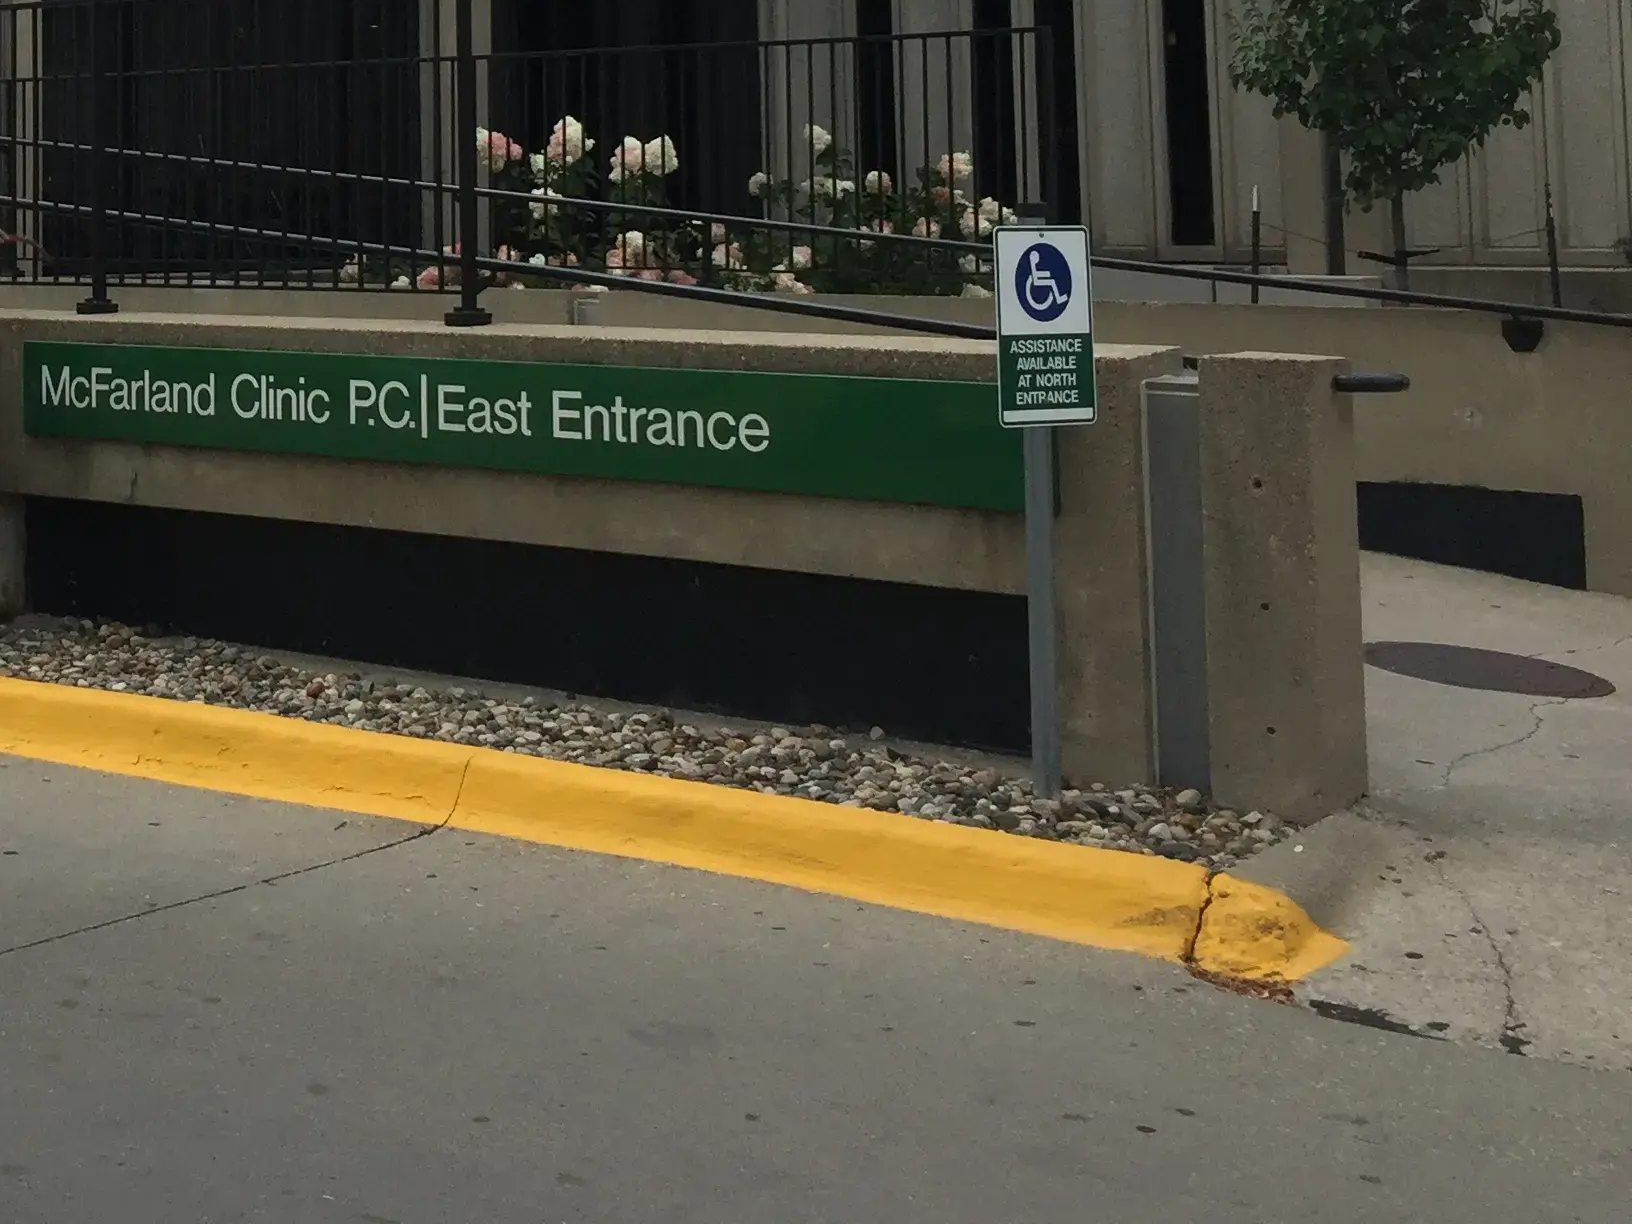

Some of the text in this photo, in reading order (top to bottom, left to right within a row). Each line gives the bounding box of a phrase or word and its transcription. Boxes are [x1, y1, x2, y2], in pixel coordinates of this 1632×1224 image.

[1009, 338, 1082, 354] ASSISTANCE
[1016, 355, 1077, 371] AVAILABLE
[1017, 373, 1077, 388] AT NORTH
[1016, 390, 1079, 405] ENTRANCE
[40, 363, 216, 417] McFarland
[229, 372, 331, 424] Clinic
[551, 389, 771, 454] Entrance
